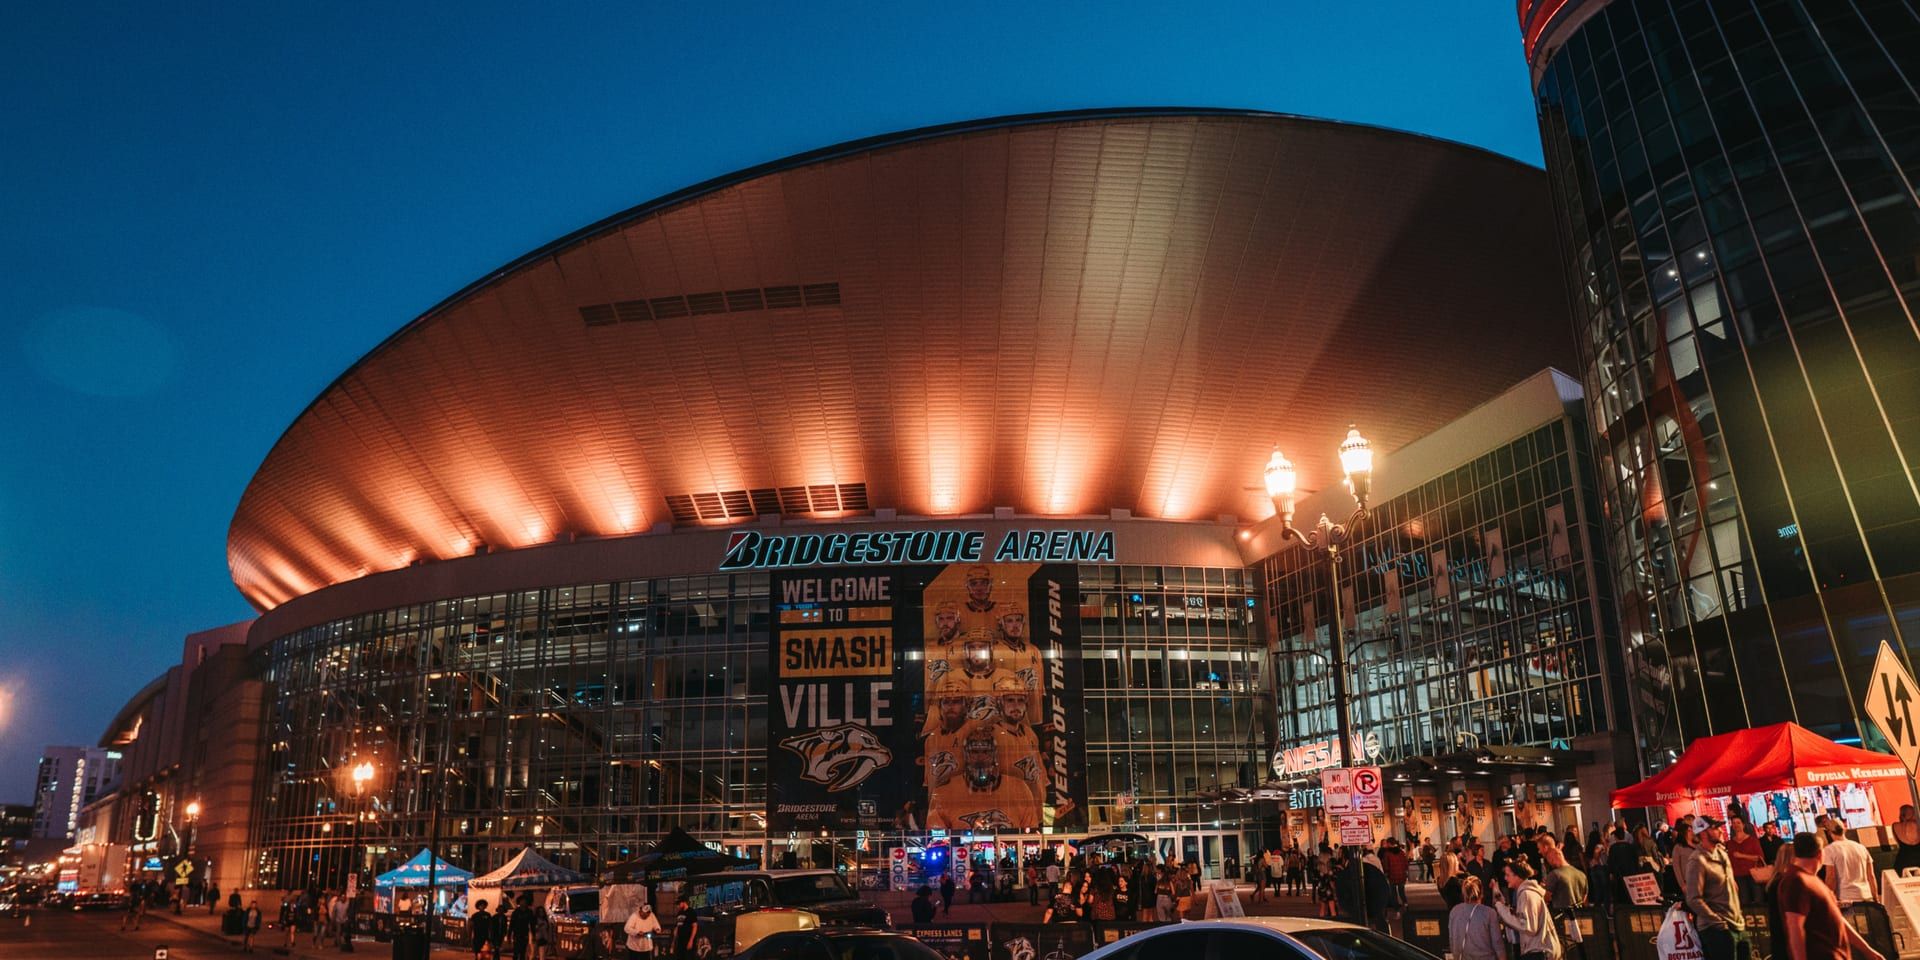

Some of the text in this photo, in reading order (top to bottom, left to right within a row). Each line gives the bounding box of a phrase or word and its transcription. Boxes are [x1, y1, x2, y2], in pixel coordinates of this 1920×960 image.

[719, 530, 1116, 570] BRIDGESTONE ARENA
[782, 576, 891, 603] WELCOME
[828, 608, 843, 622] TO
[786, 635, 886, 670] SMASH
[1047, 579, 1069, 805] YEAR OF THE FAN
[779, 682, 893, 728] VILLE
[1283, 733, 1364, 774] NISSAN
[1331, 774, 1341, 782] NO
[1807, 771, 1849, 782] OFFICIAL
[1289, 788, 1324, 810] ENTR
[1325, 785, 1350, 794] VENDING
[777, 803, 838, 813] BRIDGESTONE
[917, 929, 963, 938] EXPRESS LANES
